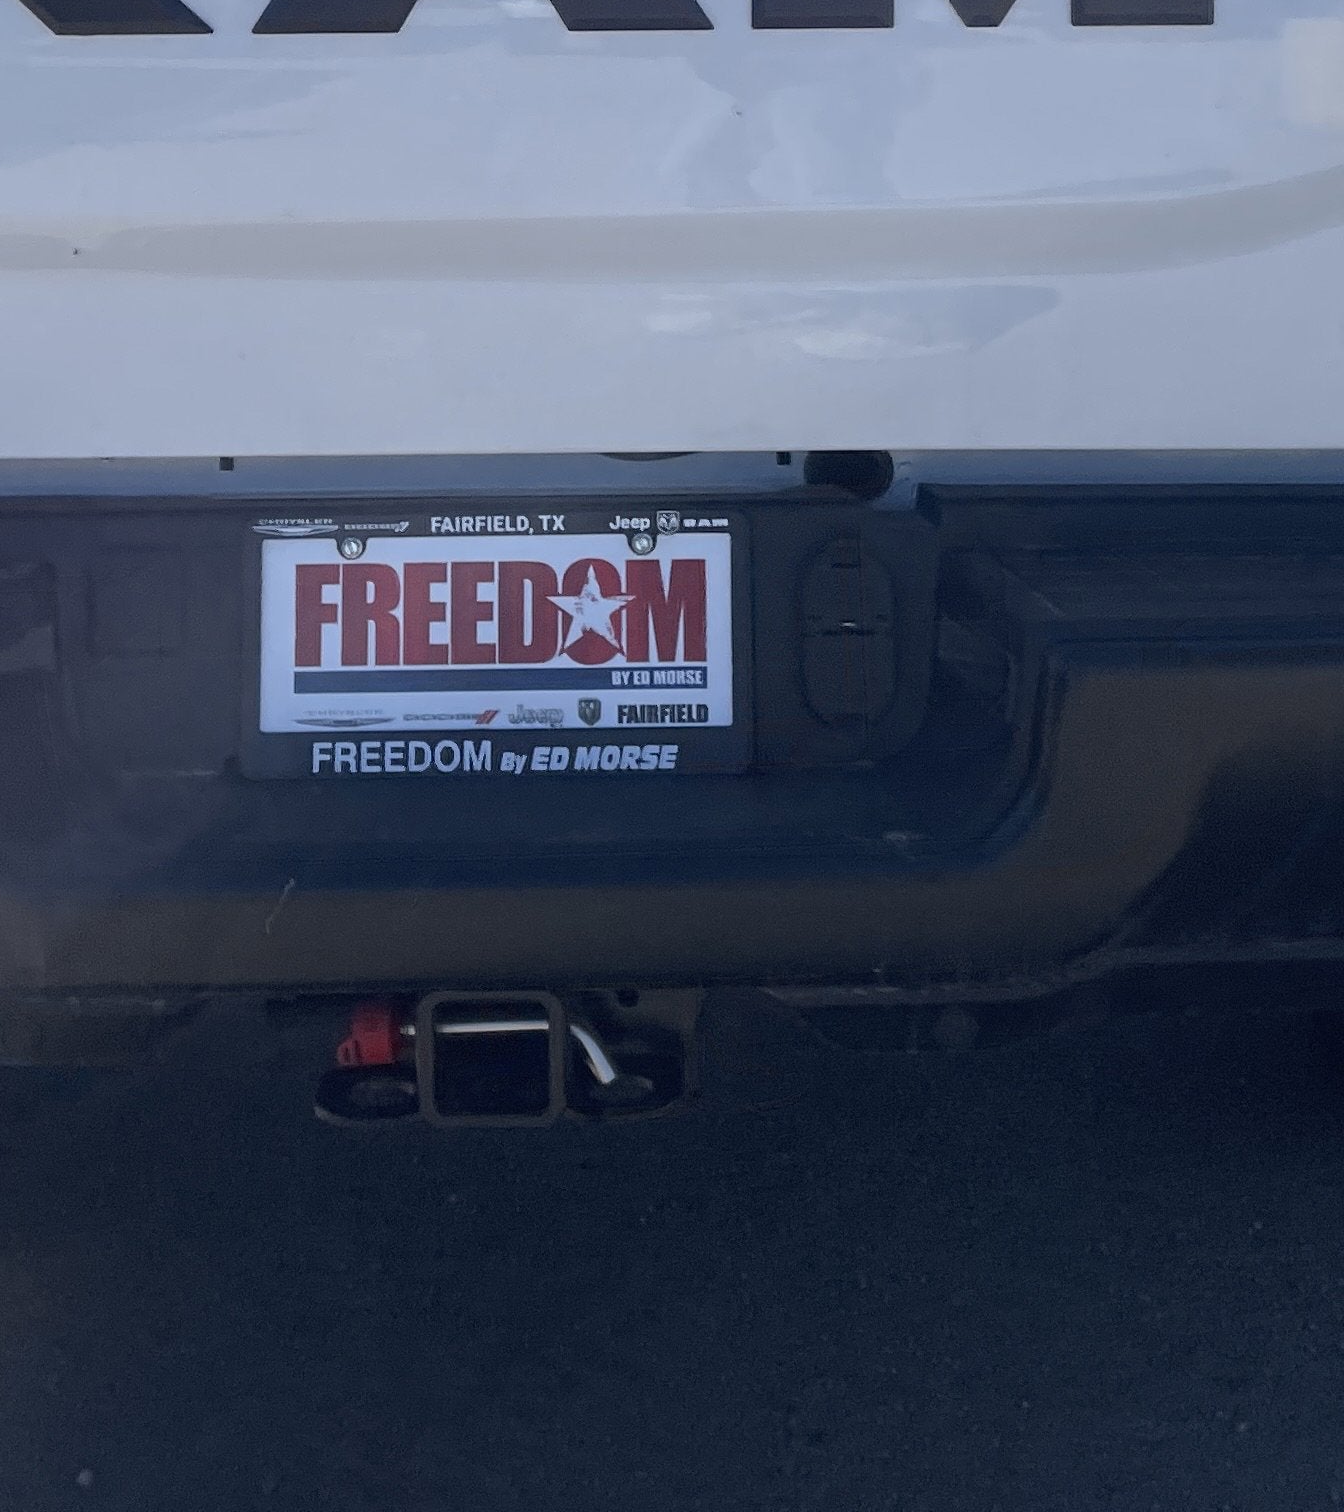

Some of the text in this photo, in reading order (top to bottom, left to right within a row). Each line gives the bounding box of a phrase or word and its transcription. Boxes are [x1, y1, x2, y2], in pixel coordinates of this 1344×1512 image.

[430, 514, 566, 535] FAIRFIELD, TX
[609, 515, 651, 531] Jeep
[295, 558, 708, 667] FREEDOM
[611, 669, 704, 686] BY ED MORSE
[617, 703, 709, 724] FAIRFIELD
[312, 739, 679, 775] FREEDOM By ED MORSE
